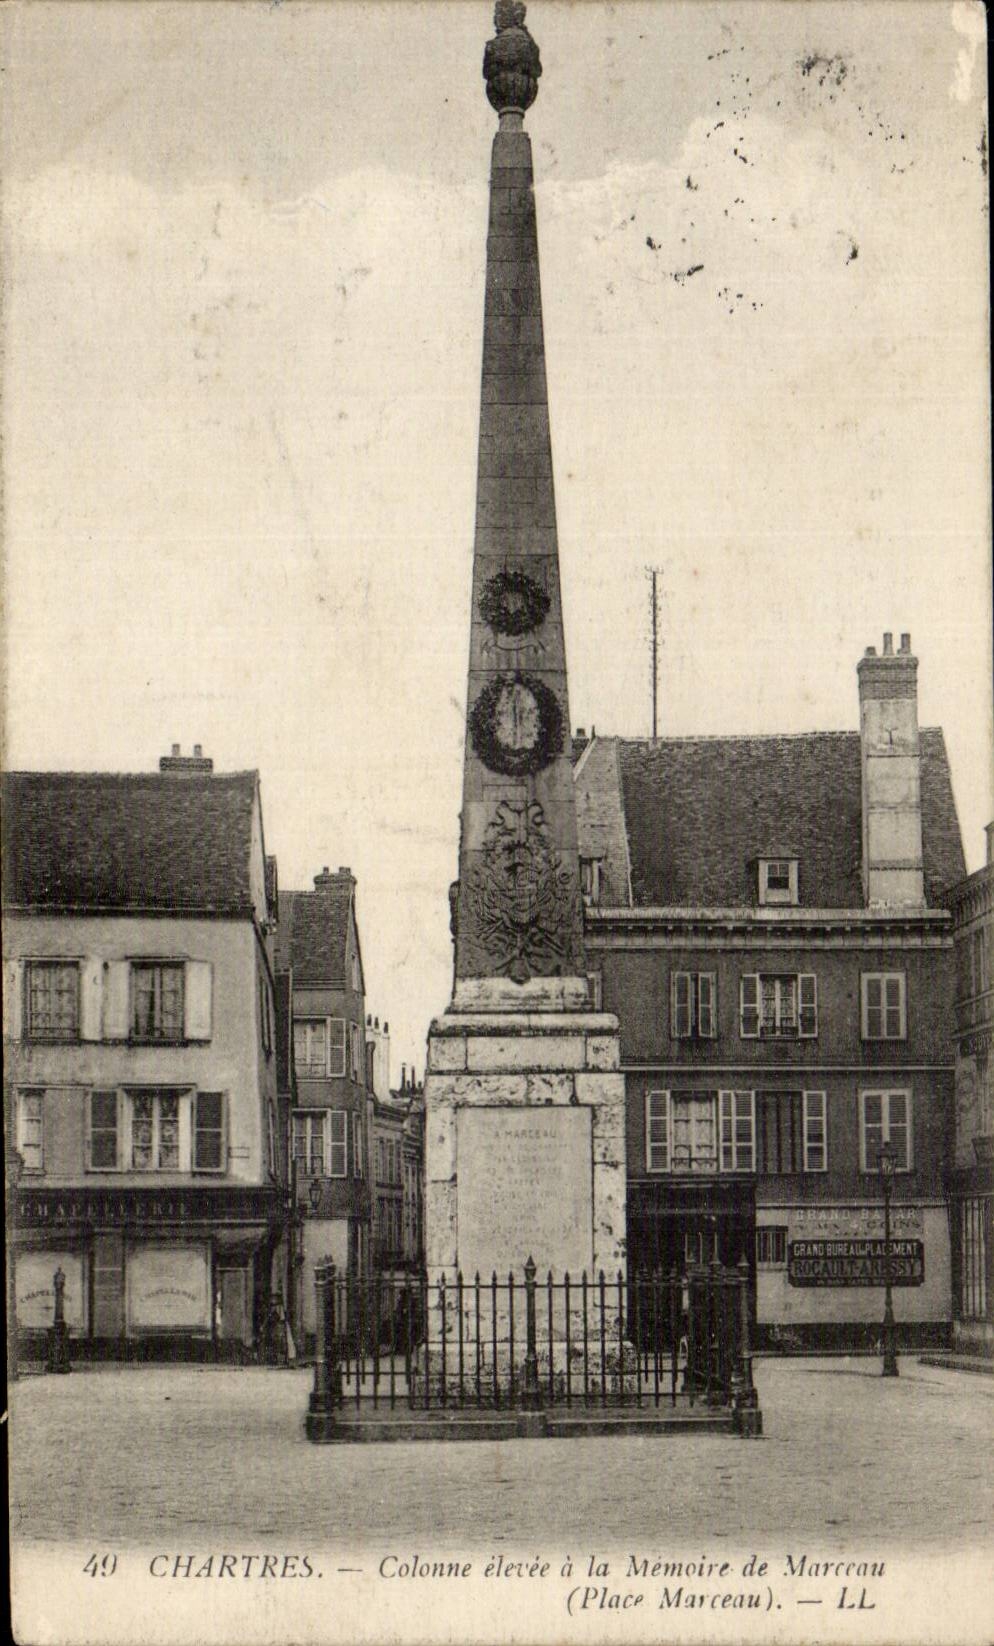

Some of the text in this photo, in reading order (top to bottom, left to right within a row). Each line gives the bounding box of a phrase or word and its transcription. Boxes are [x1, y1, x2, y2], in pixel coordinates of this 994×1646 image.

[504, 1129, 557, 1139] MARCEAU
[860, 1208, 916, 1220] BAAR
[793, 1243, 825, 1257] GRAND
